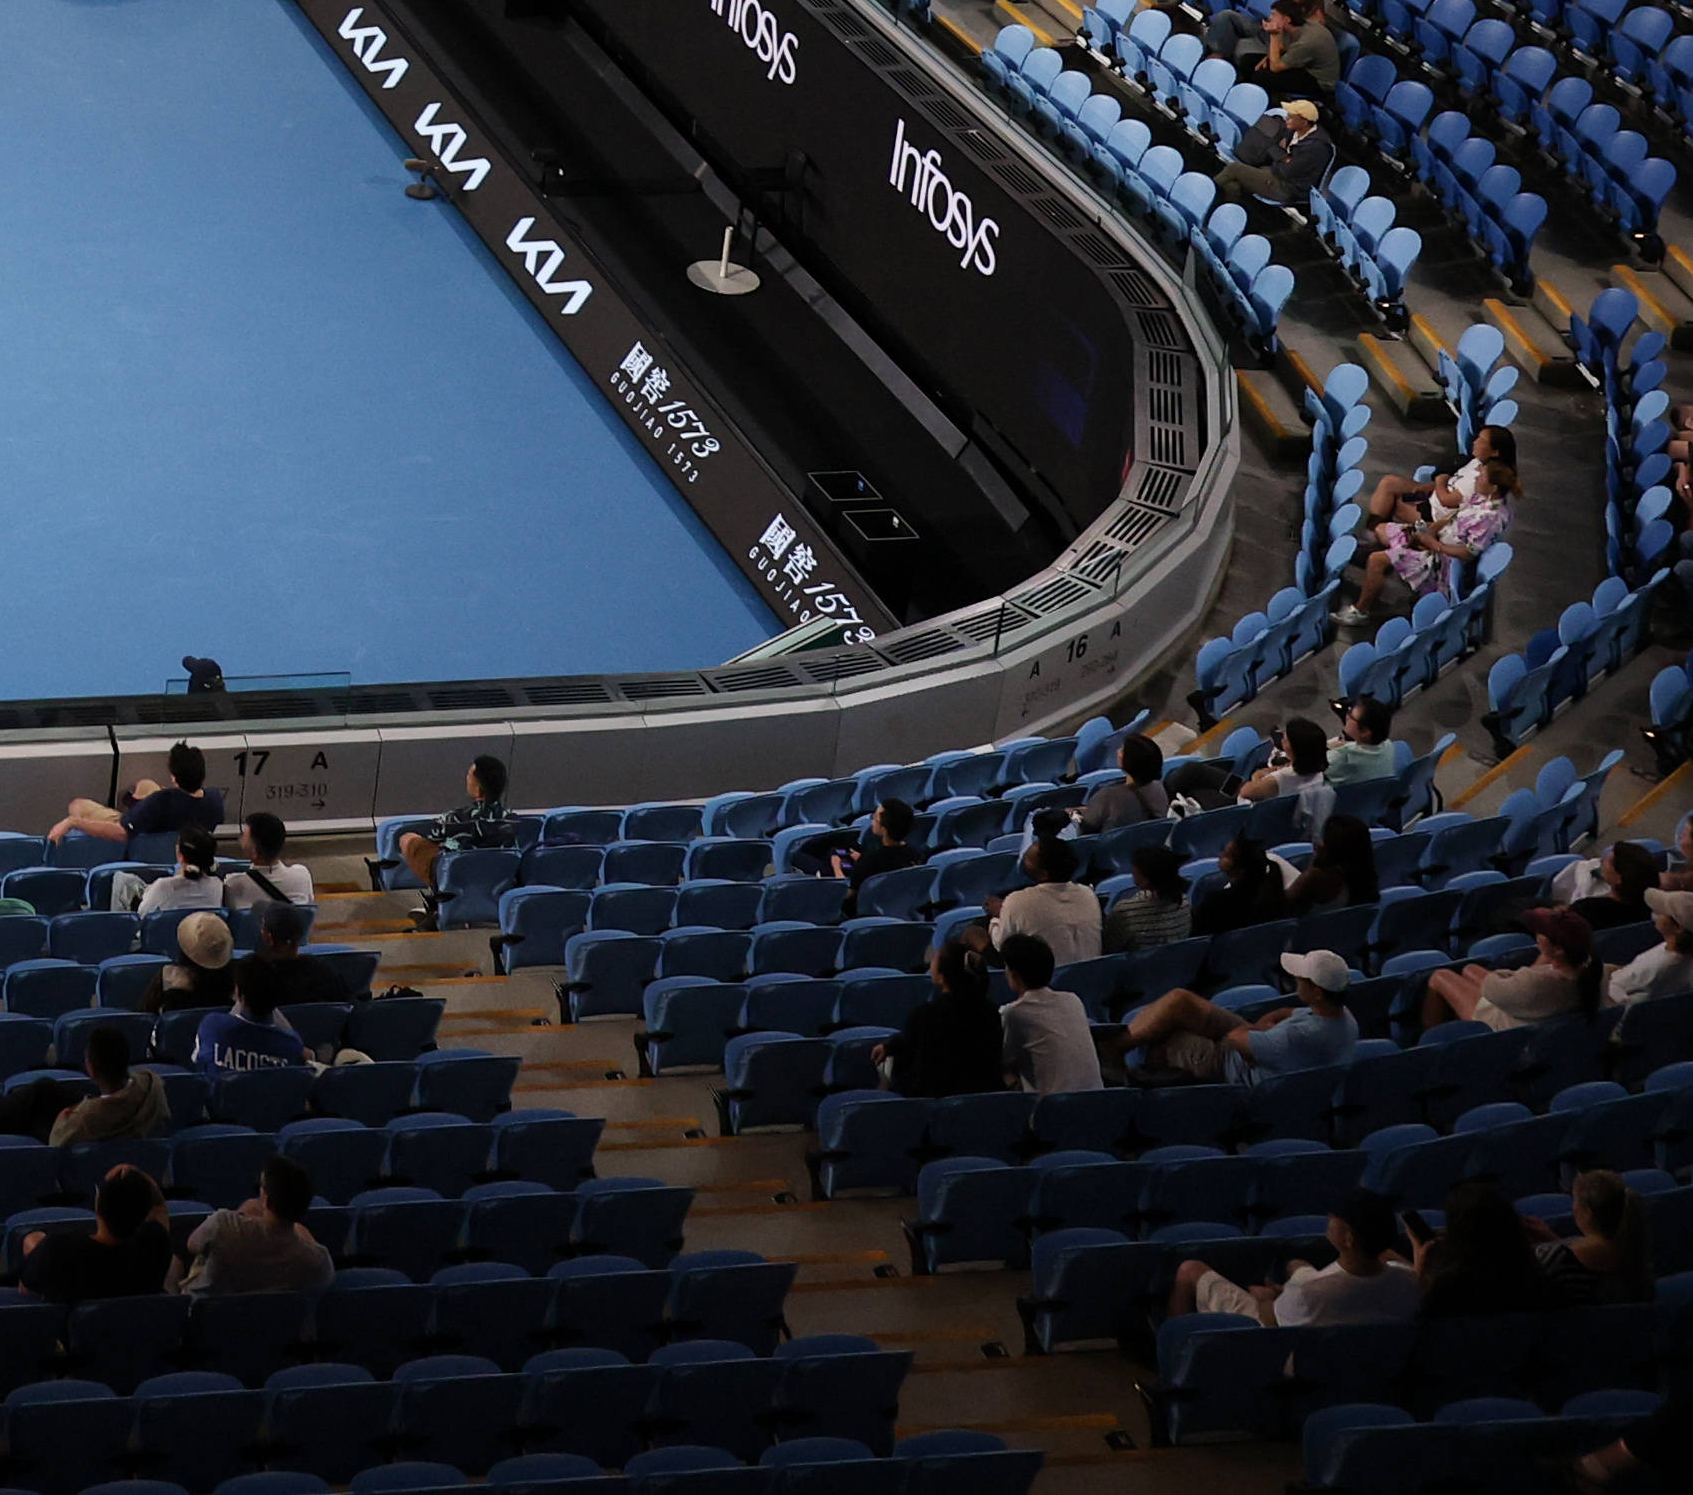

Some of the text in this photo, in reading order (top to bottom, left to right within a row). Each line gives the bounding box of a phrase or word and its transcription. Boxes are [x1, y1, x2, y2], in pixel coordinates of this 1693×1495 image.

[889, 118, 1000, 276] Infosys
[610, 371, 699, 484] GUOJIAO 1573
[749, 546, 811, 623] GUOJIAO
[1067, 634, 1088, 663] 16
[234, 751, 328, 776] 17 A
[214, 1043, 288, 1071] LACO
